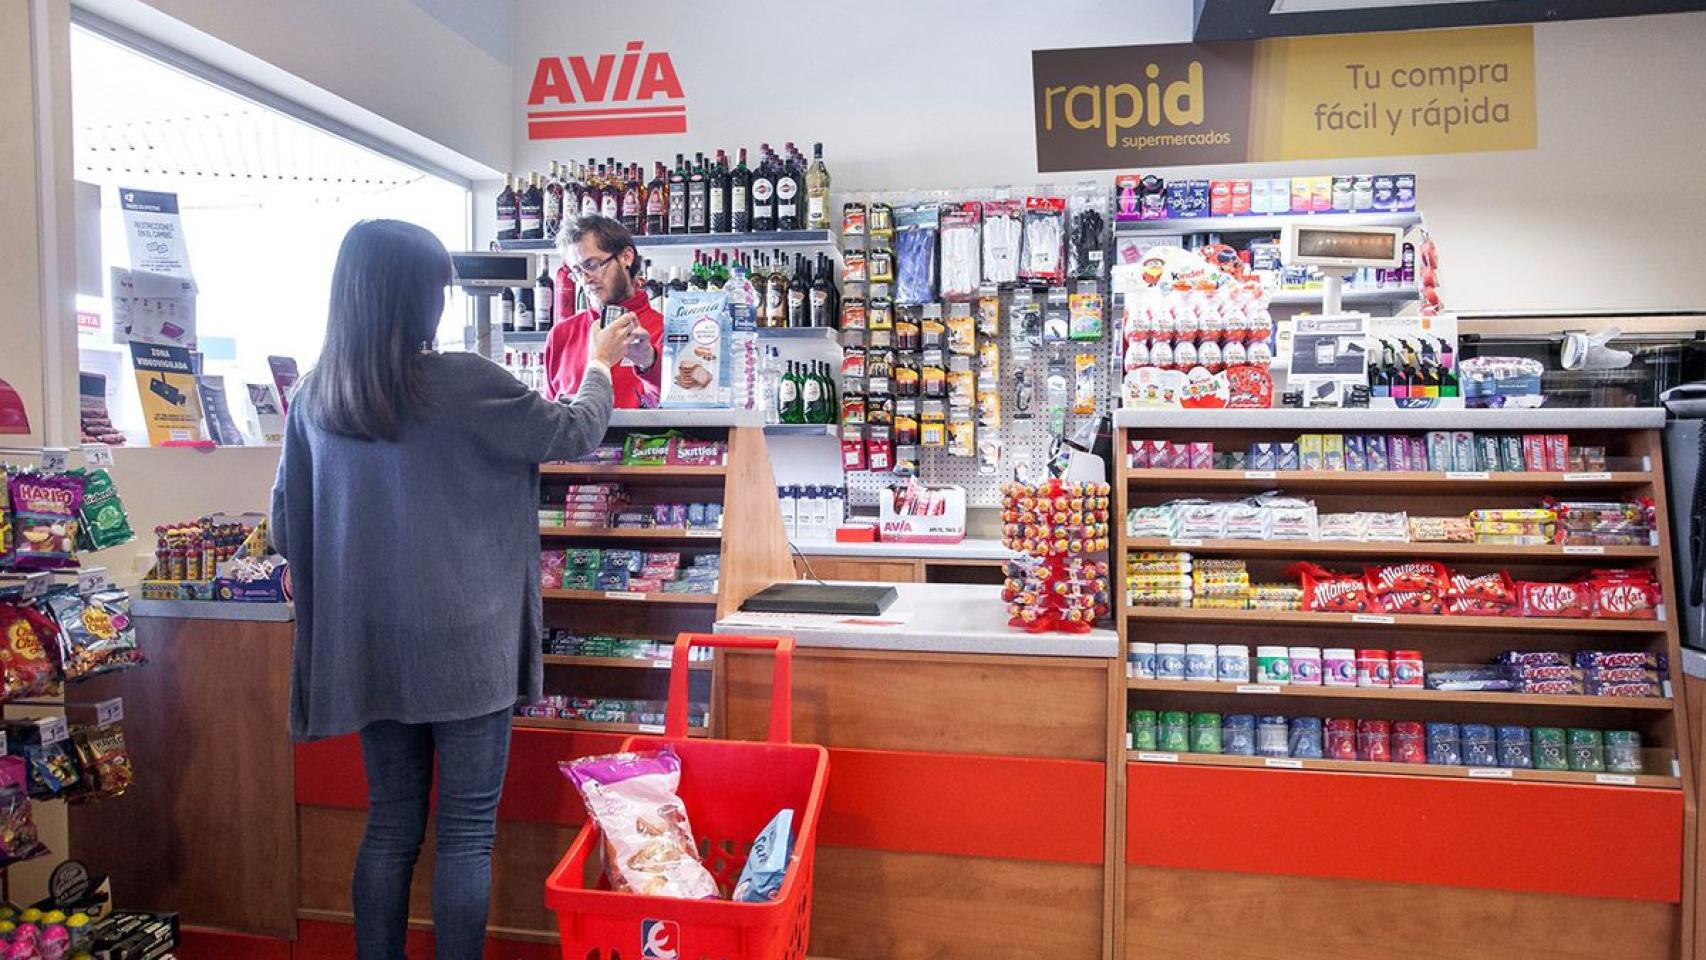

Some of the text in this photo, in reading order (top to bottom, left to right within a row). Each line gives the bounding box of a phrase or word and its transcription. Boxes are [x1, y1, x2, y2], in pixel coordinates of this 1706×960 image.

[1345, 61, 1510, 98] Tu compra
[1044, 60, 1205, 148] rapid
[1314, 99, 1510, 136] fácil y rápida
[1122, 129, 1231, 150] supermercados
[1171, 269, 1205, 281] Kinder
[136, 357, 189, 369] VIDEOVIGILADA
[150, 347, 171, 358] ZONA
[677, 446, 719, 459] Skittles
[19, 484, 74, 504] HARIBO
[1379, 563, 1436, 587] Maltesers
[1535, 586, 1575, 610] KitKat
[1605, 586, 1646, 611] KitKat
